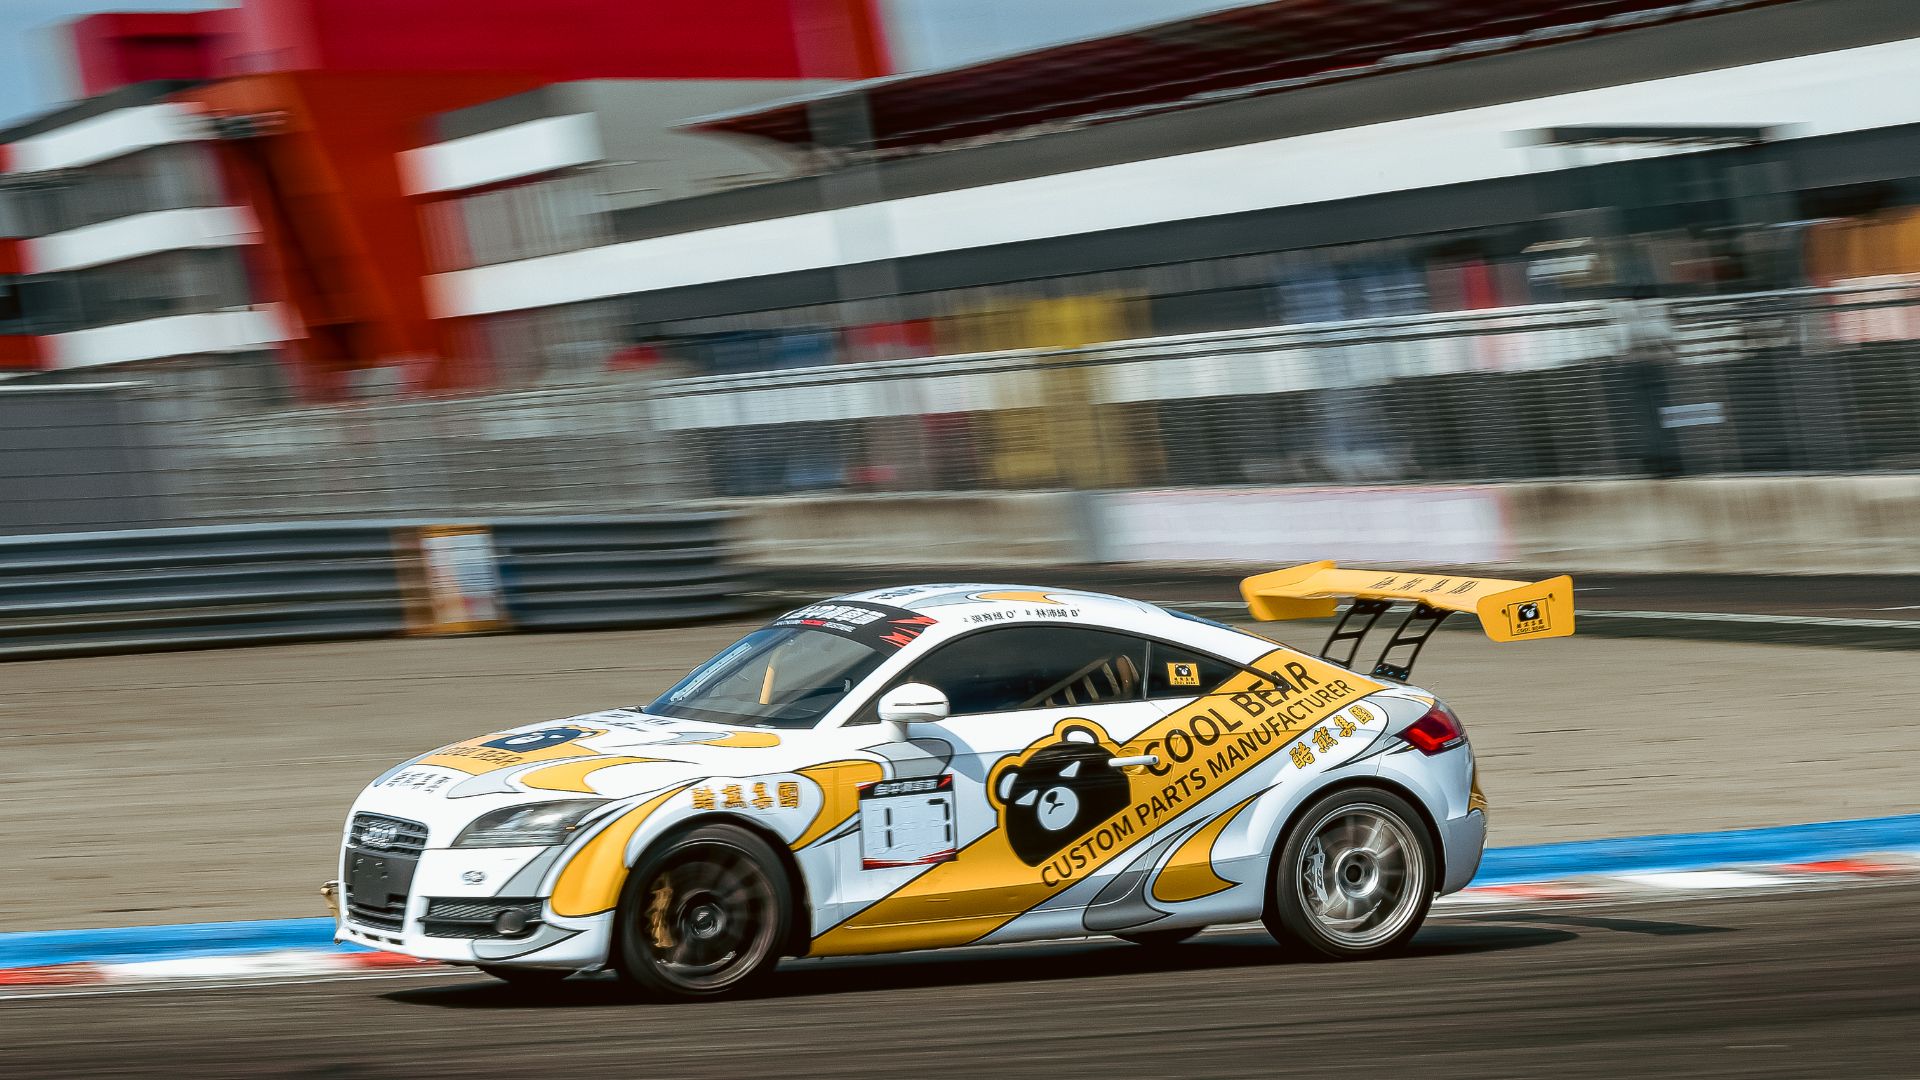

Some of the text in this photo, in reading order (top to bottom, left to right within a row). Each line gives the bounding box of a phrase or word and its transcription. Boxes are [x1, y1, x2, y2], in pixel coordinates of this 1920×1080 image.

[1142, 660, 1319, 777] COOL BEAR
[1289, 705, 1374, 769] 酷熊集團
[1041, 678, 1356, 888] CUSTOM PARTS MANUFACTURER
